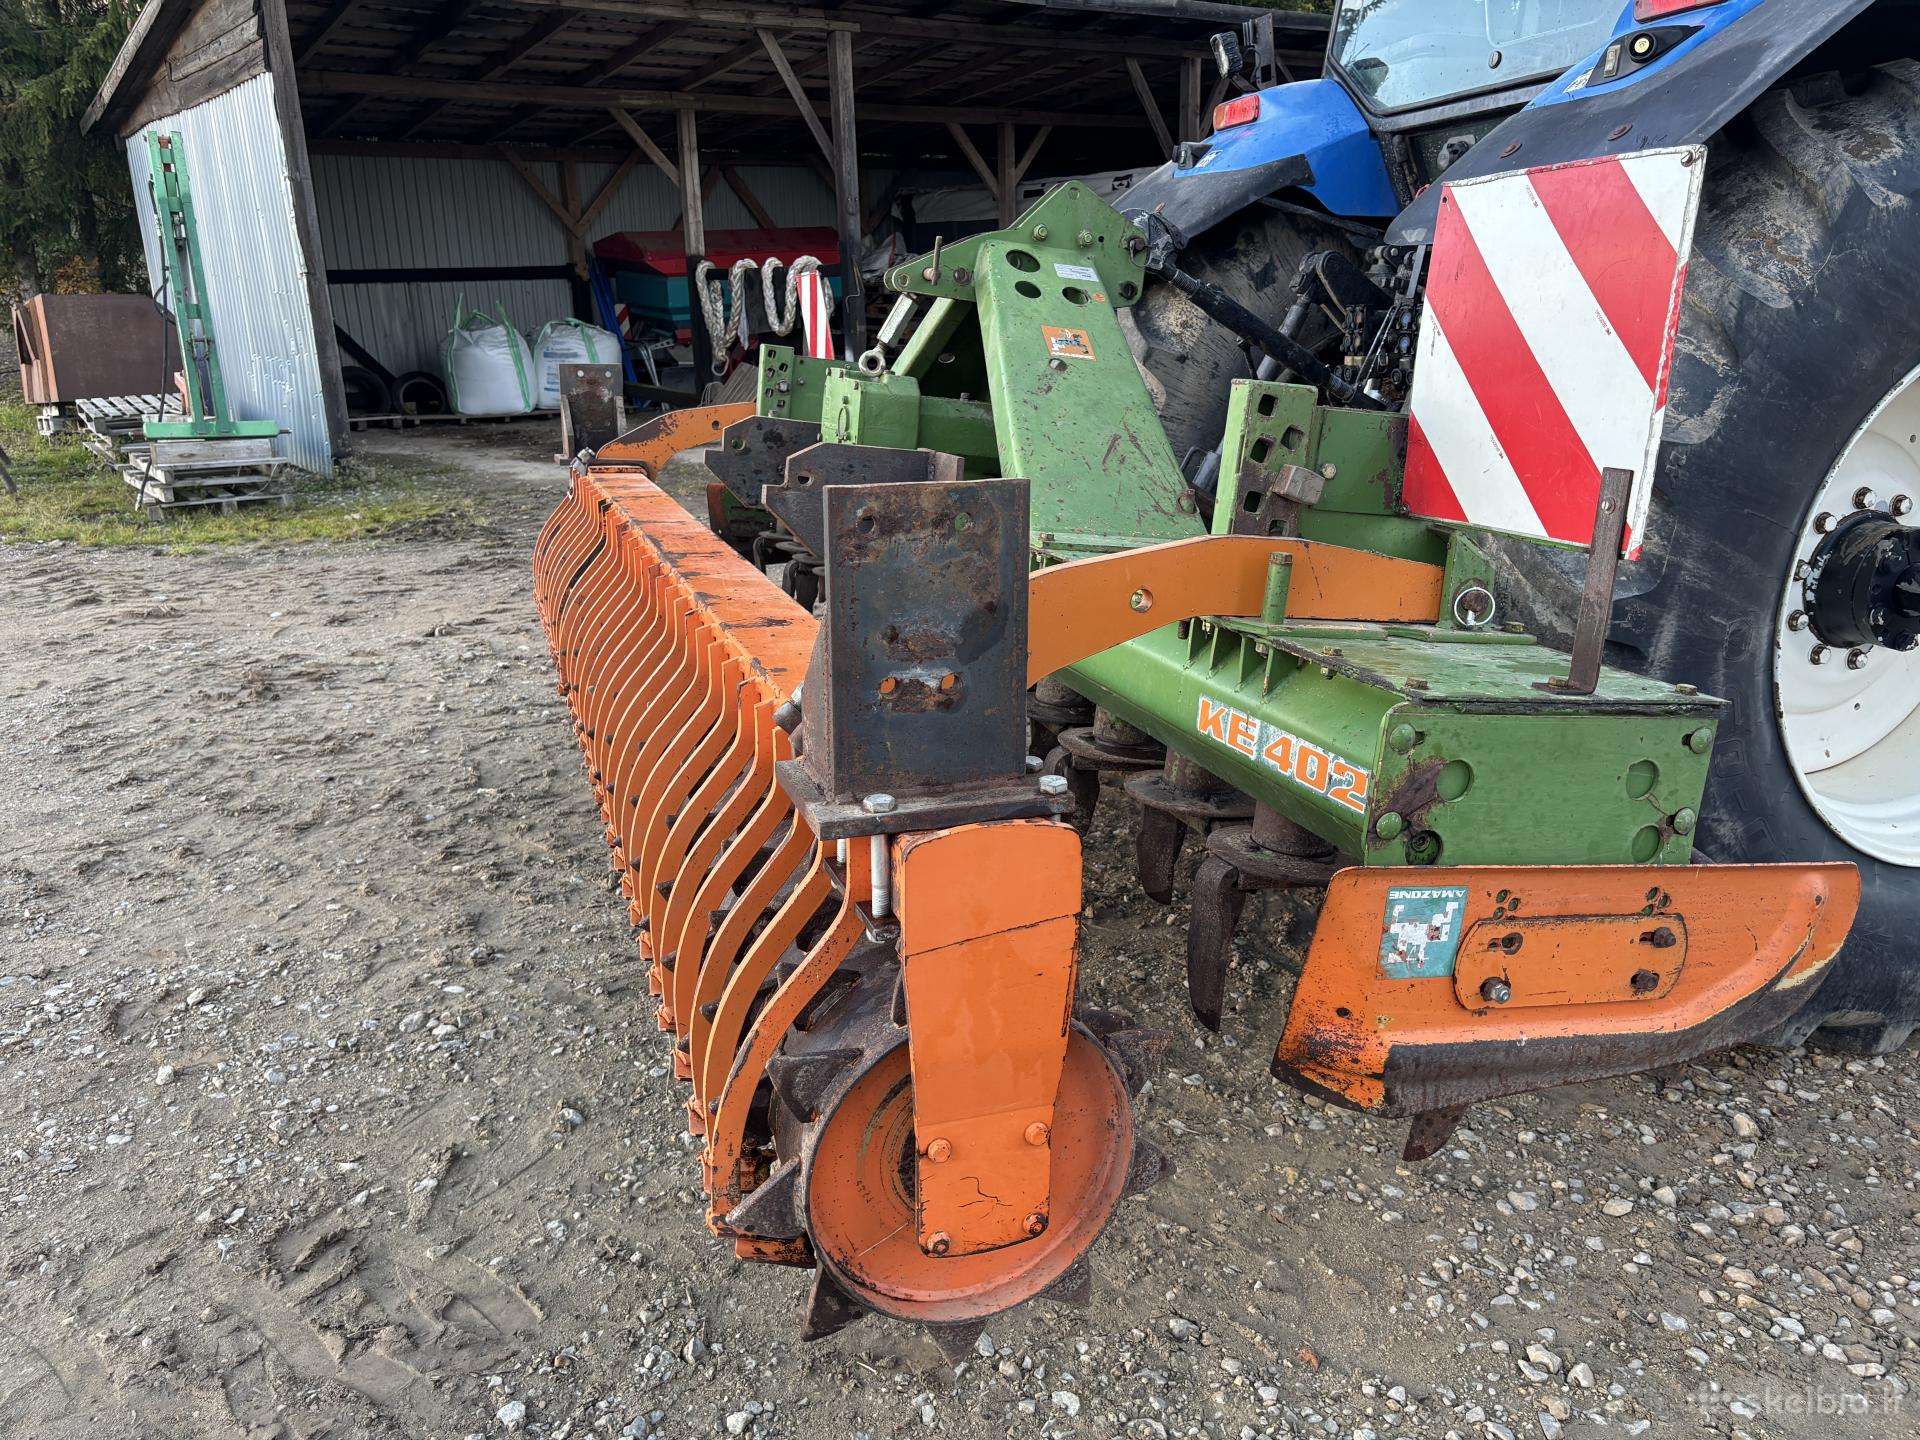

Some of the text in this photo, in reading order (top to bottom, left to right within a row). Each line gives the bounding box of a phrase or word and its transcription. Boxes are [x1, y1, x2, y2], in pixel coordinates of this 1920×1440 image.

[1198, 696, 1370, 813] KE 402
[1389, 890, 1466, 900] AMAZONE
